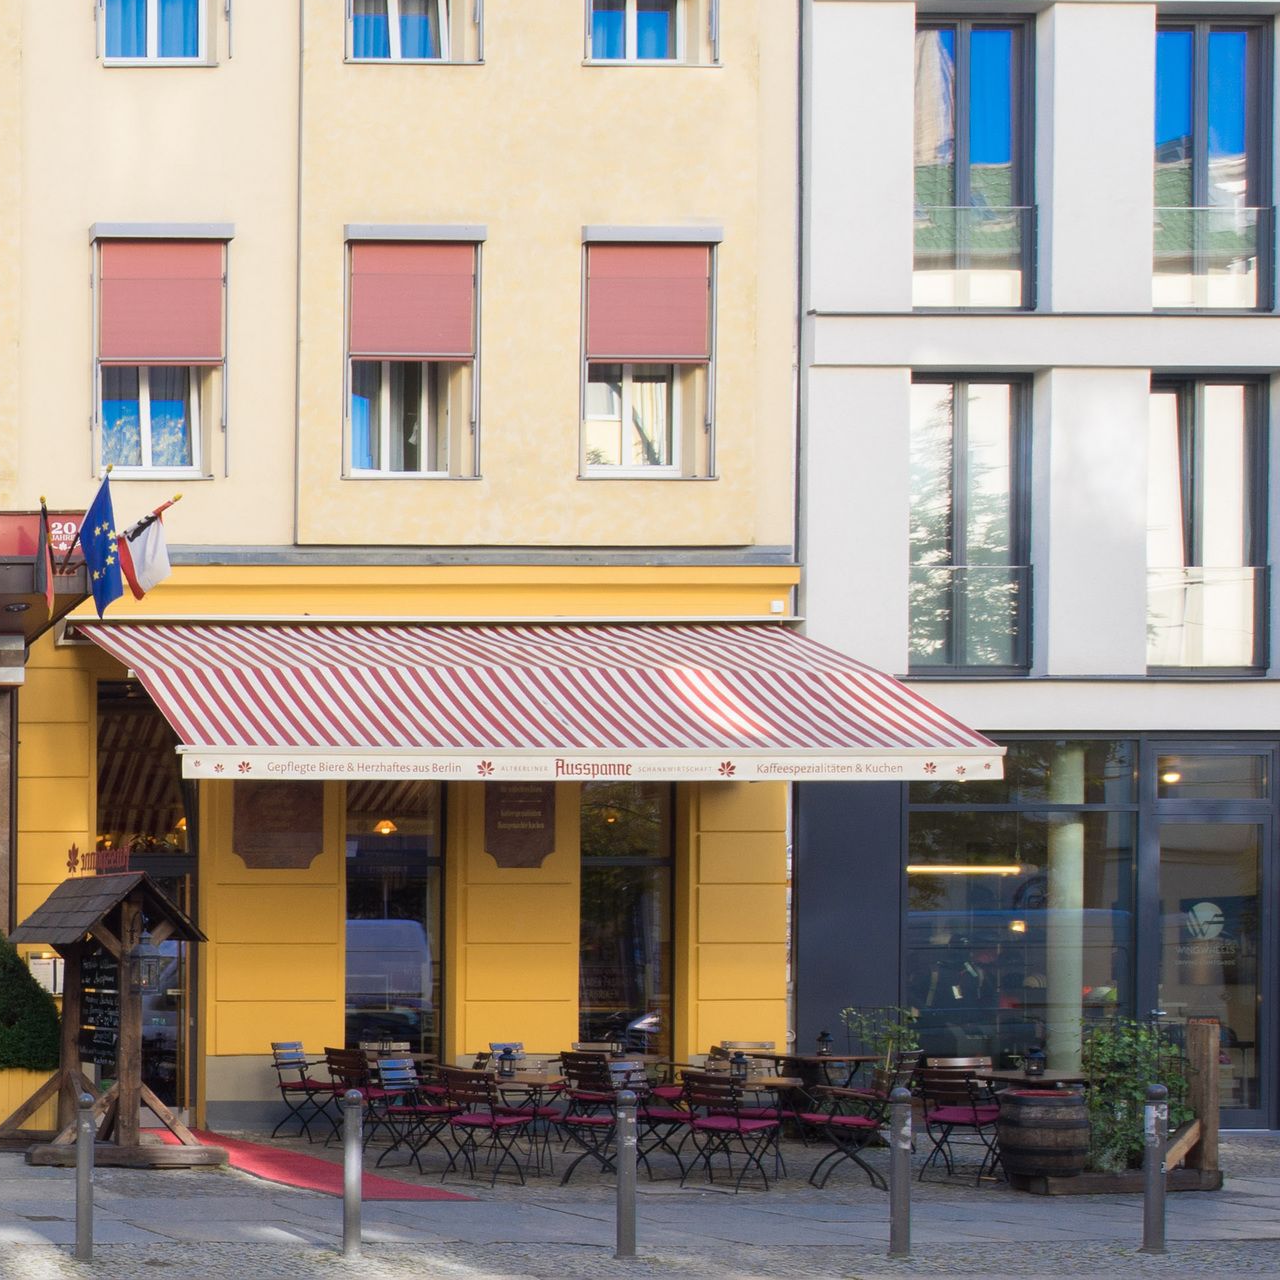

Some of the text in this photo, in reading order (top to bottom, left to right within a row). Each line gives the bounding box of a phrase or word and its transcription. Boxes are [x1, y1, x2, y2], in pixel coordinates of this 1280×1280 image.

[51, 522, 77, 535] 20
[266, 761, 462, 774] Gepflegte Biere & Herzhaftes aus Berlin
[554, 758, 633, 778] Ausspanne
[756, 763, 904, 775] Kaffeespezialitäten & Kuchen
